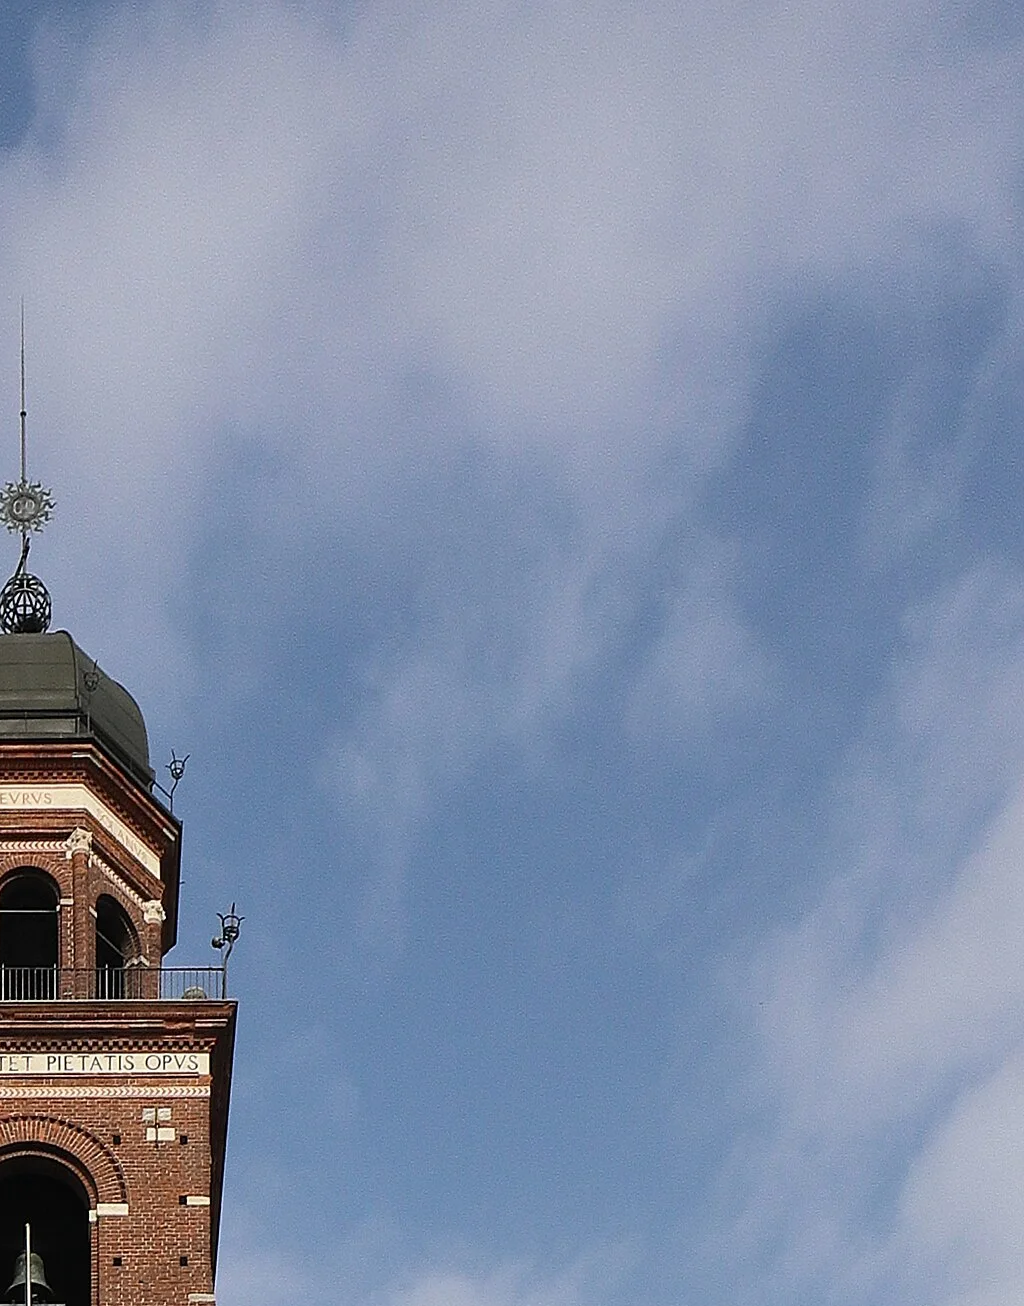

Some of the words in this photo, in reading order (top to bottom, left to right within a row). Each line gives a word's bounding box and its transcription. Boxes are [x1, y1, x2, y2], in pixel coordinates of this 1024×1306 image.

[0, 792, 52, 805] EVRVS
[47, 1055, 134, 1071] PIETATIS
[145, 1055, 199, 1070] OPVS
